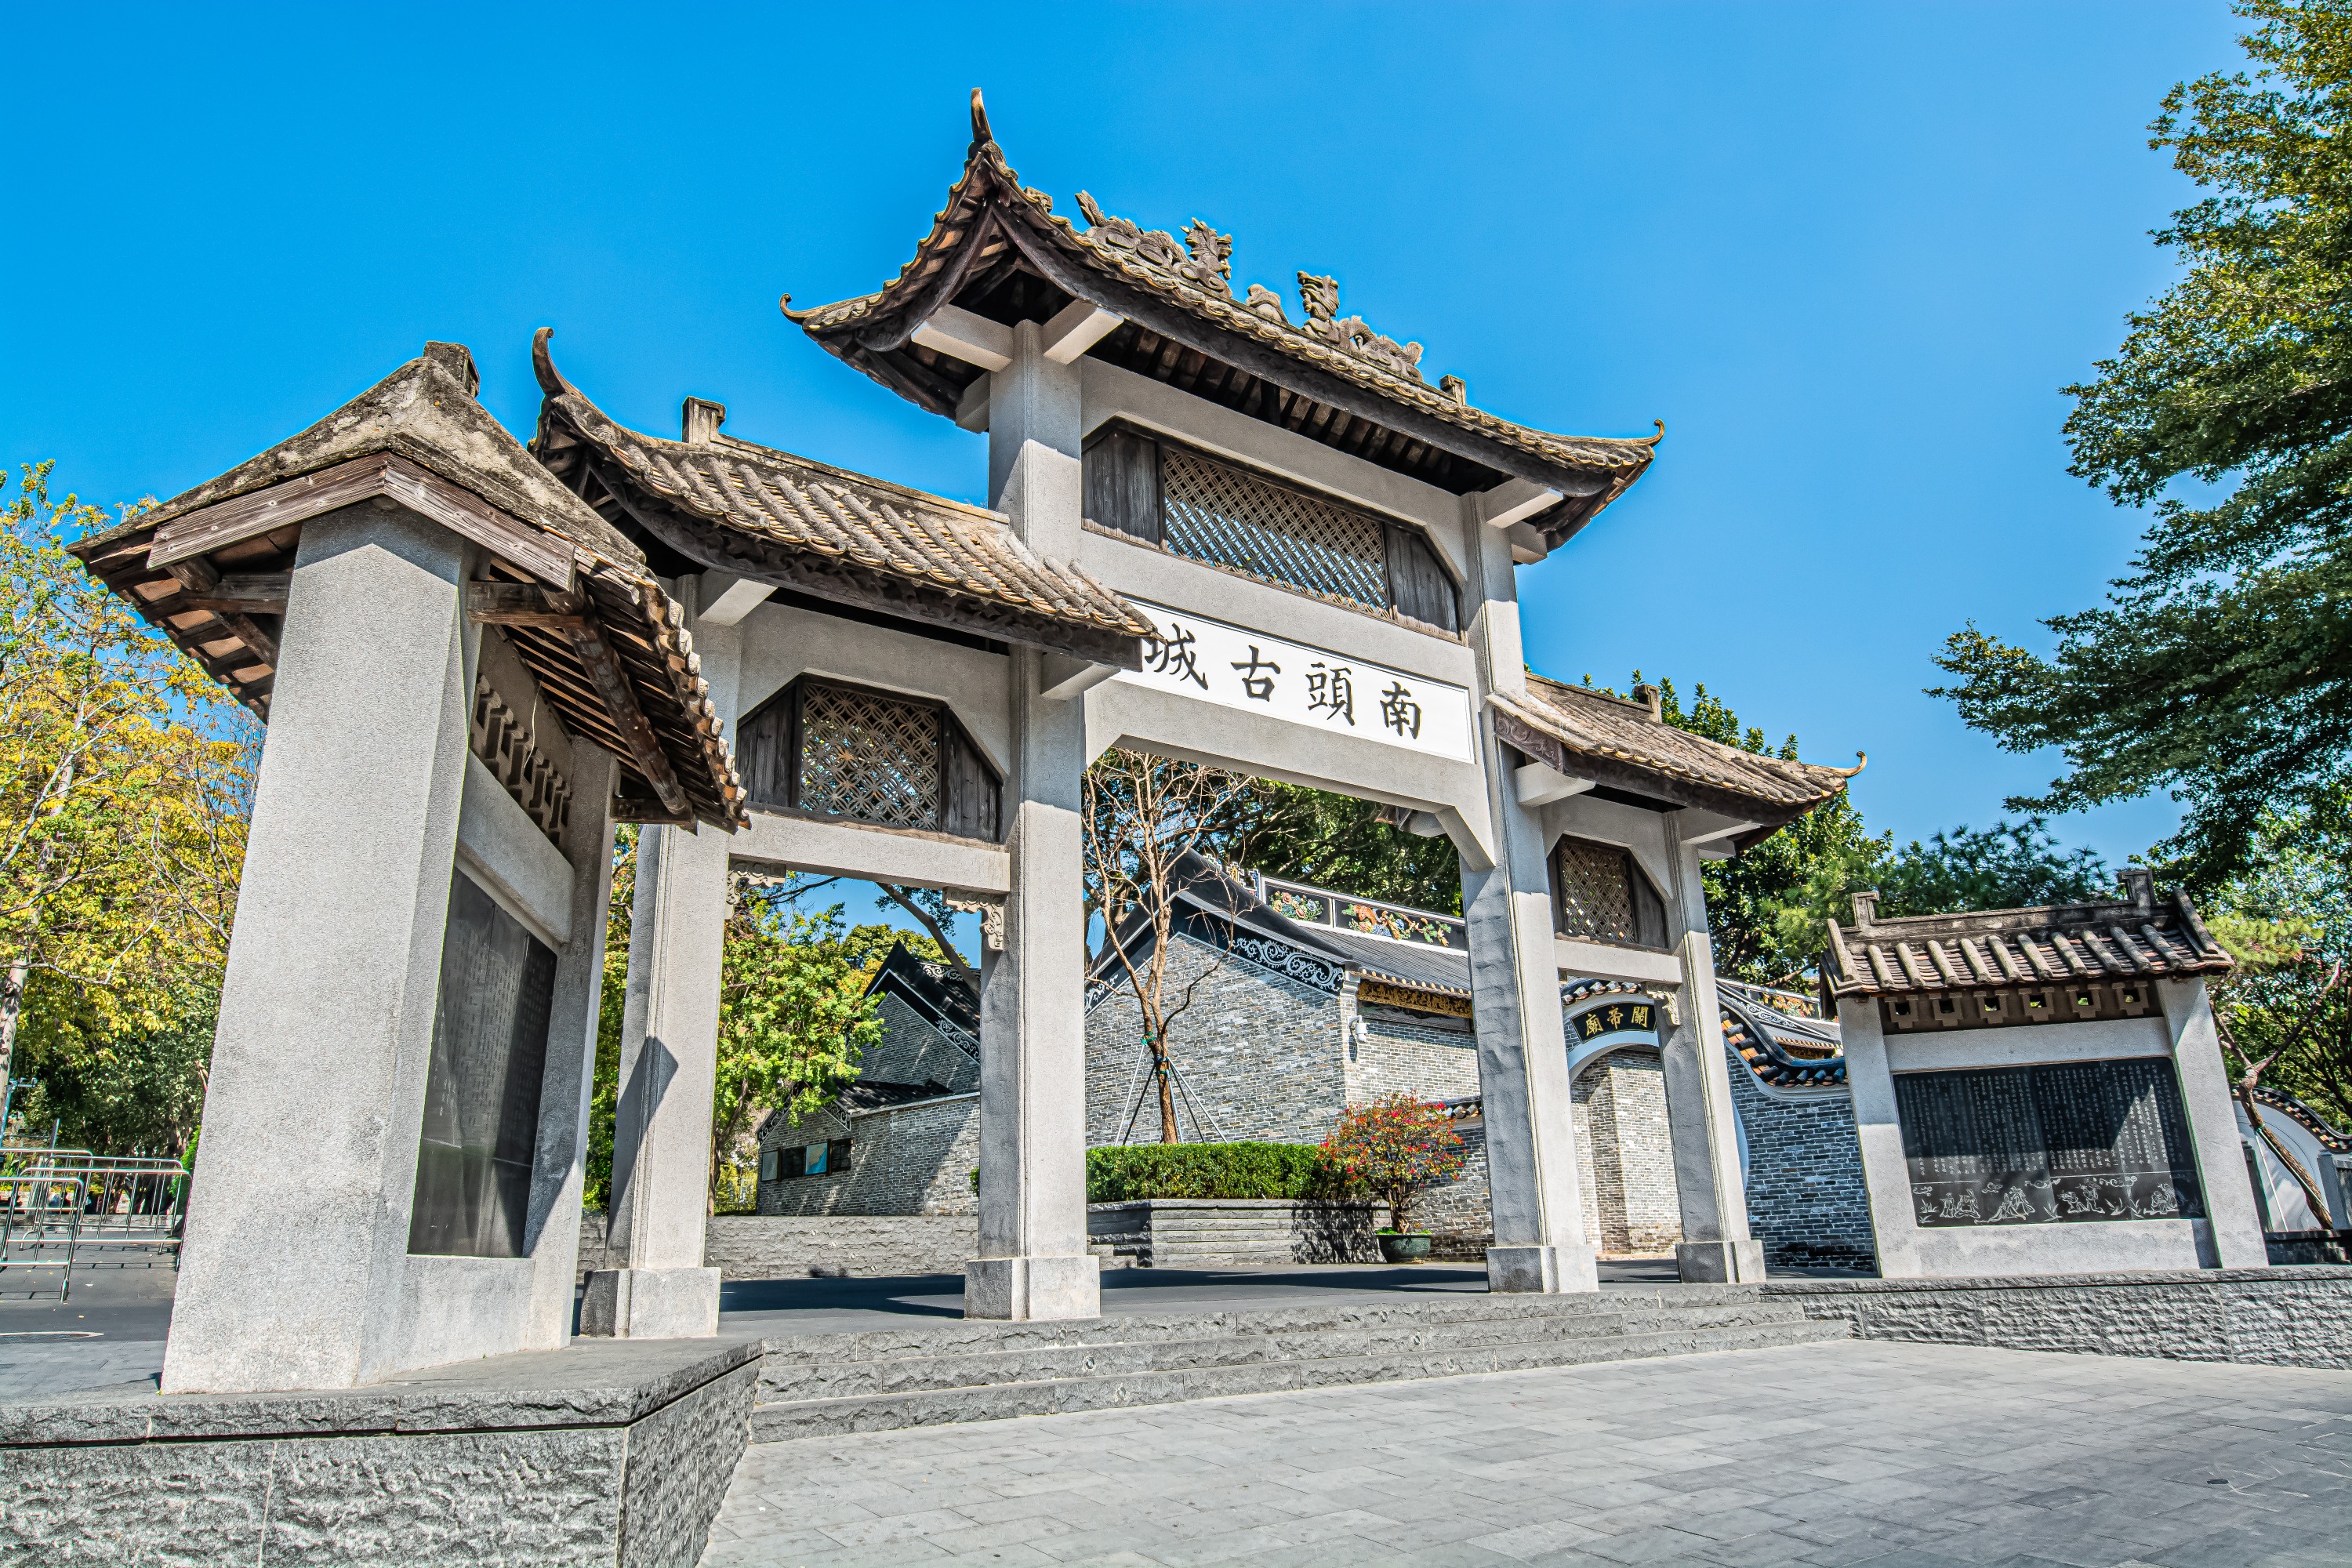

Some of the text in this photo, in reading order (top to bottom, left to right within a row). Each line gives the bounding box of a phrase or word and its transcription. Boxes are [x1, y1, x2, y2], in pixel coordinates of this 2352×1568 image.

[1144, 622, 1422, 741] 南頭古城
[1585, 1005, 1649, 1036] 關帝廟
